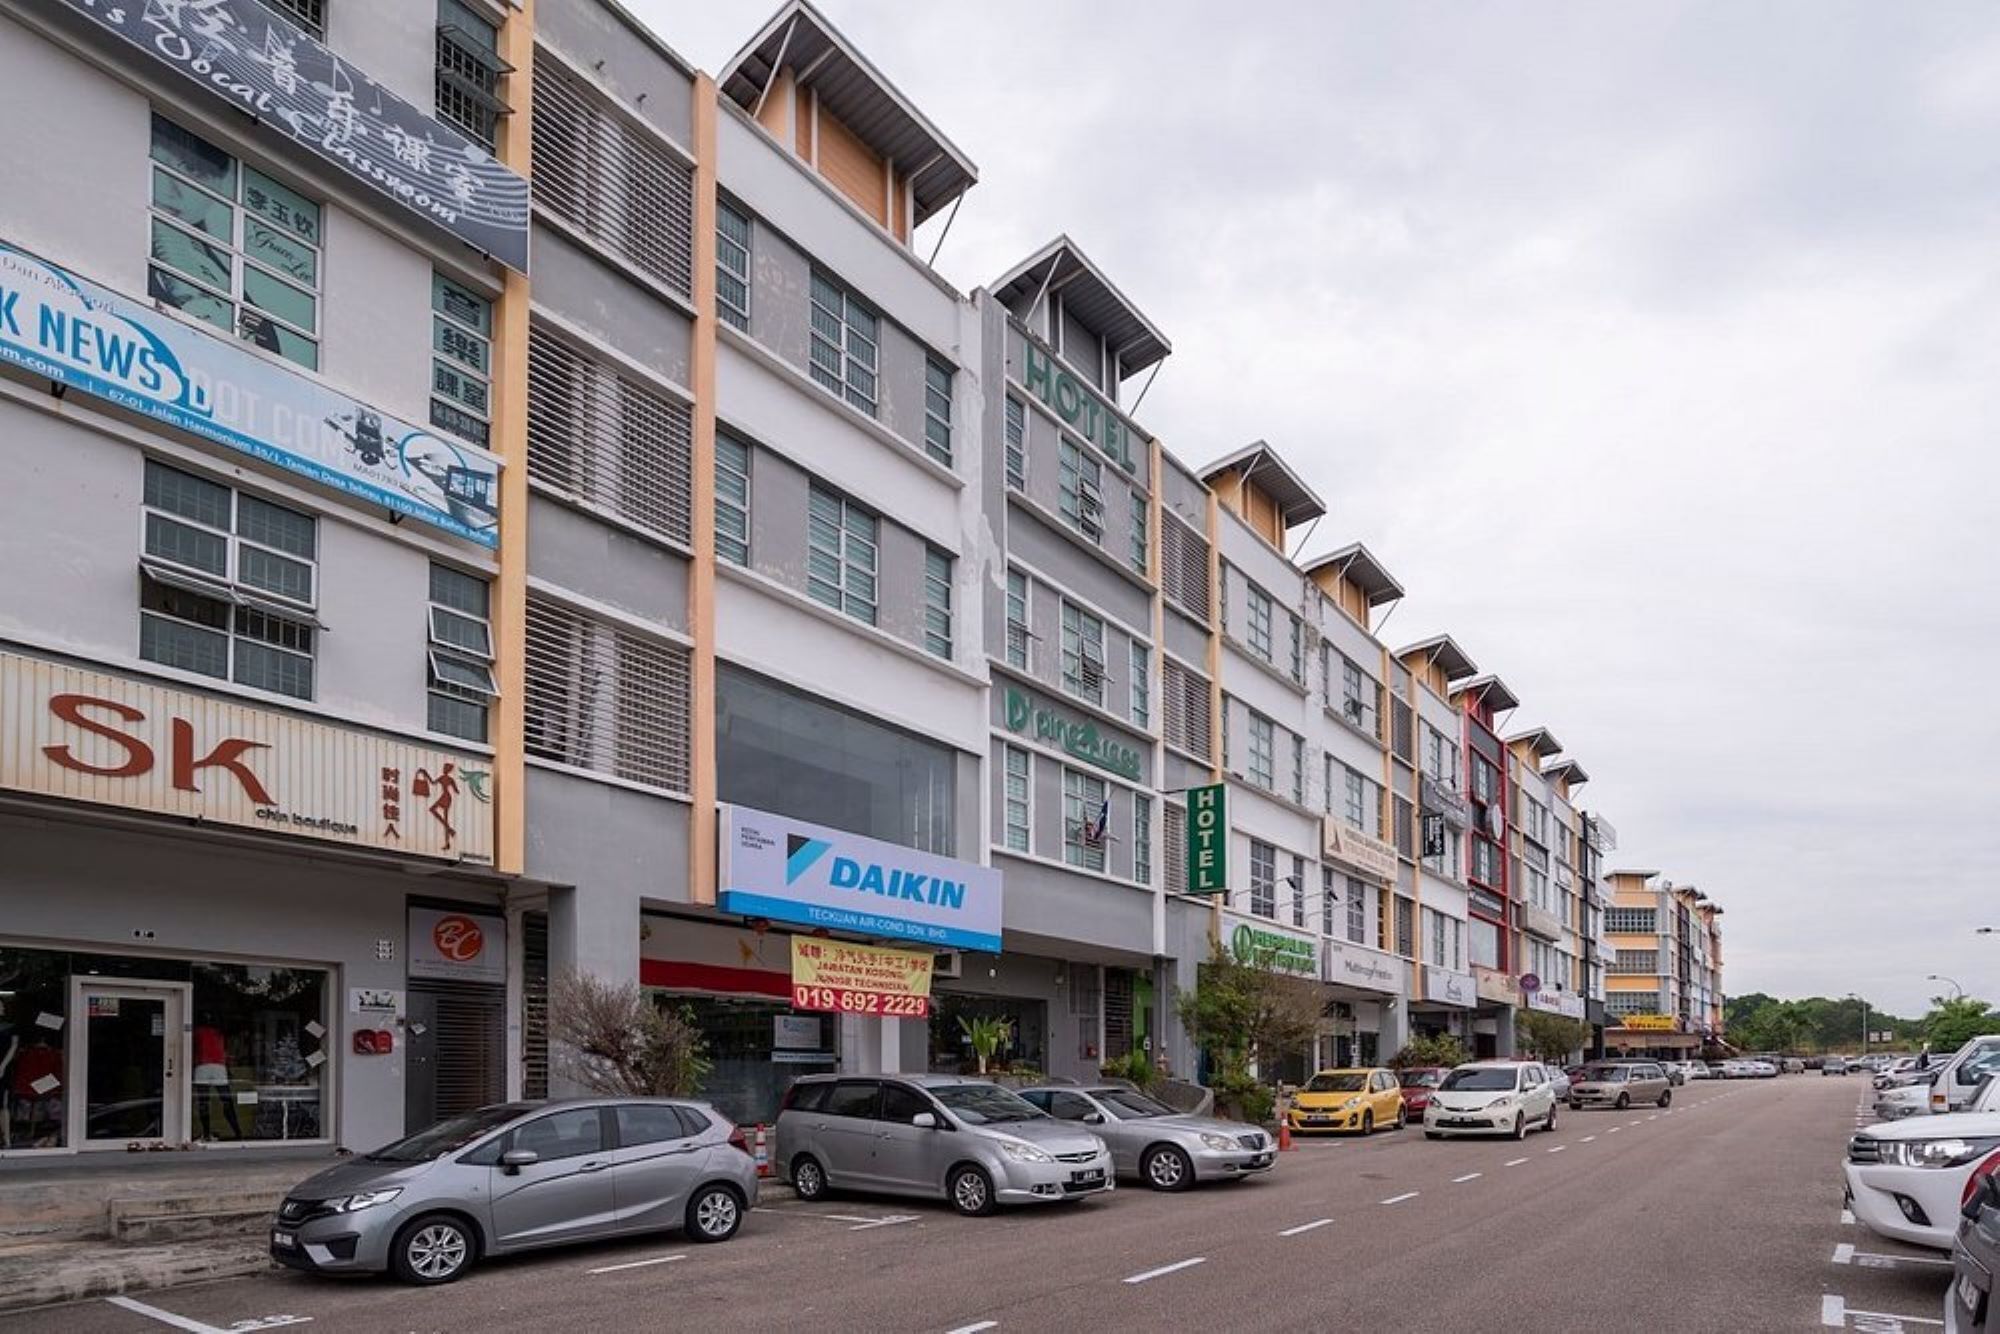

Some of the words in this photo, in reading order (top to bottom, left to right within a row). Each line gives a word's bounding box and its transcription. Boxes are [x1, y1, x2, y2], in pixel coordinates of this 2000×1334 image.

[275, 106, 457, 223] Classroom
[39, 303, 161, 391] NEWS
[188, 366, 260, 432] DOT
[1024, 340, 1136, 475] HOTEL
[151, 401, 181, 427] Jalan
[285, 457, 320, 479] Taman
[322, 468, 347, 488] Desa
[42, 693, 278, 806] SK
[256, 807, 289, 825] chin
[292, 812, 358, 835] boutique
[1197, 789, 1215, 888] HOTEL
[829, 856, 965, 909] DAIKIN
[808, 907, 857, 925] TECKUAN
[859, 915, 904, 933] AIR-COND
[796, 987, 835, 1008] 019
[841, 991, 878, 1012] 692
[883, 995, 925, 1015] 2229
[817, 961, 862, 974] JAWATAN
[855, 978, 909, 991] TECHNICIAN
